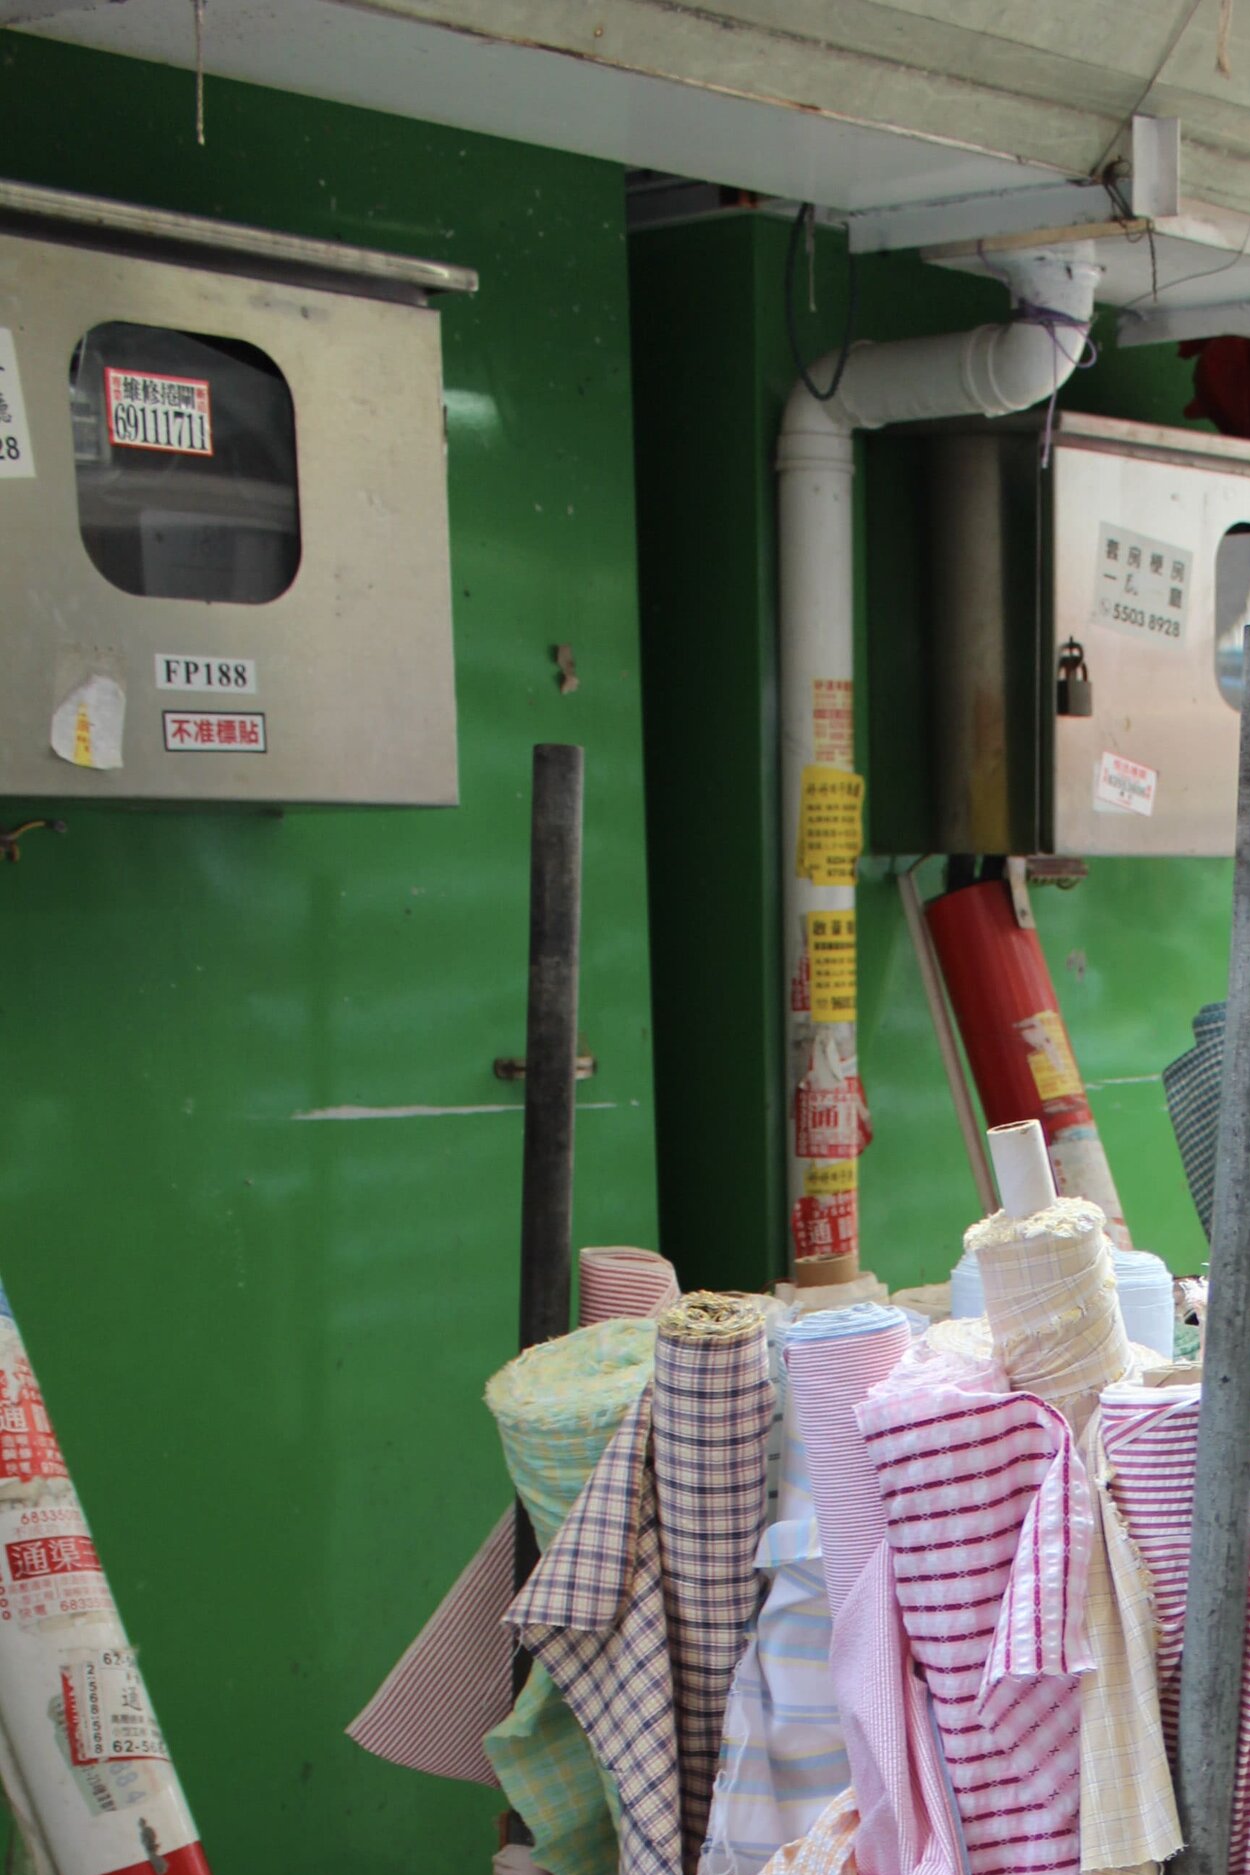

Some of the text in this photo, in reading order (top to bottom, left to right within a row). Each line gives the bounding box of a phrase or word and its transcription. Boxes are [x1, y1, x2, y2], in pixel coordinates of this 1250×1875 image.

[114, 403, 209, 451] 69111711
[1113, 602, 1180, 638] 5503 8928
[164, 659, 248, 688] FP188
[171, 719, 259, 745] 不准標貼
